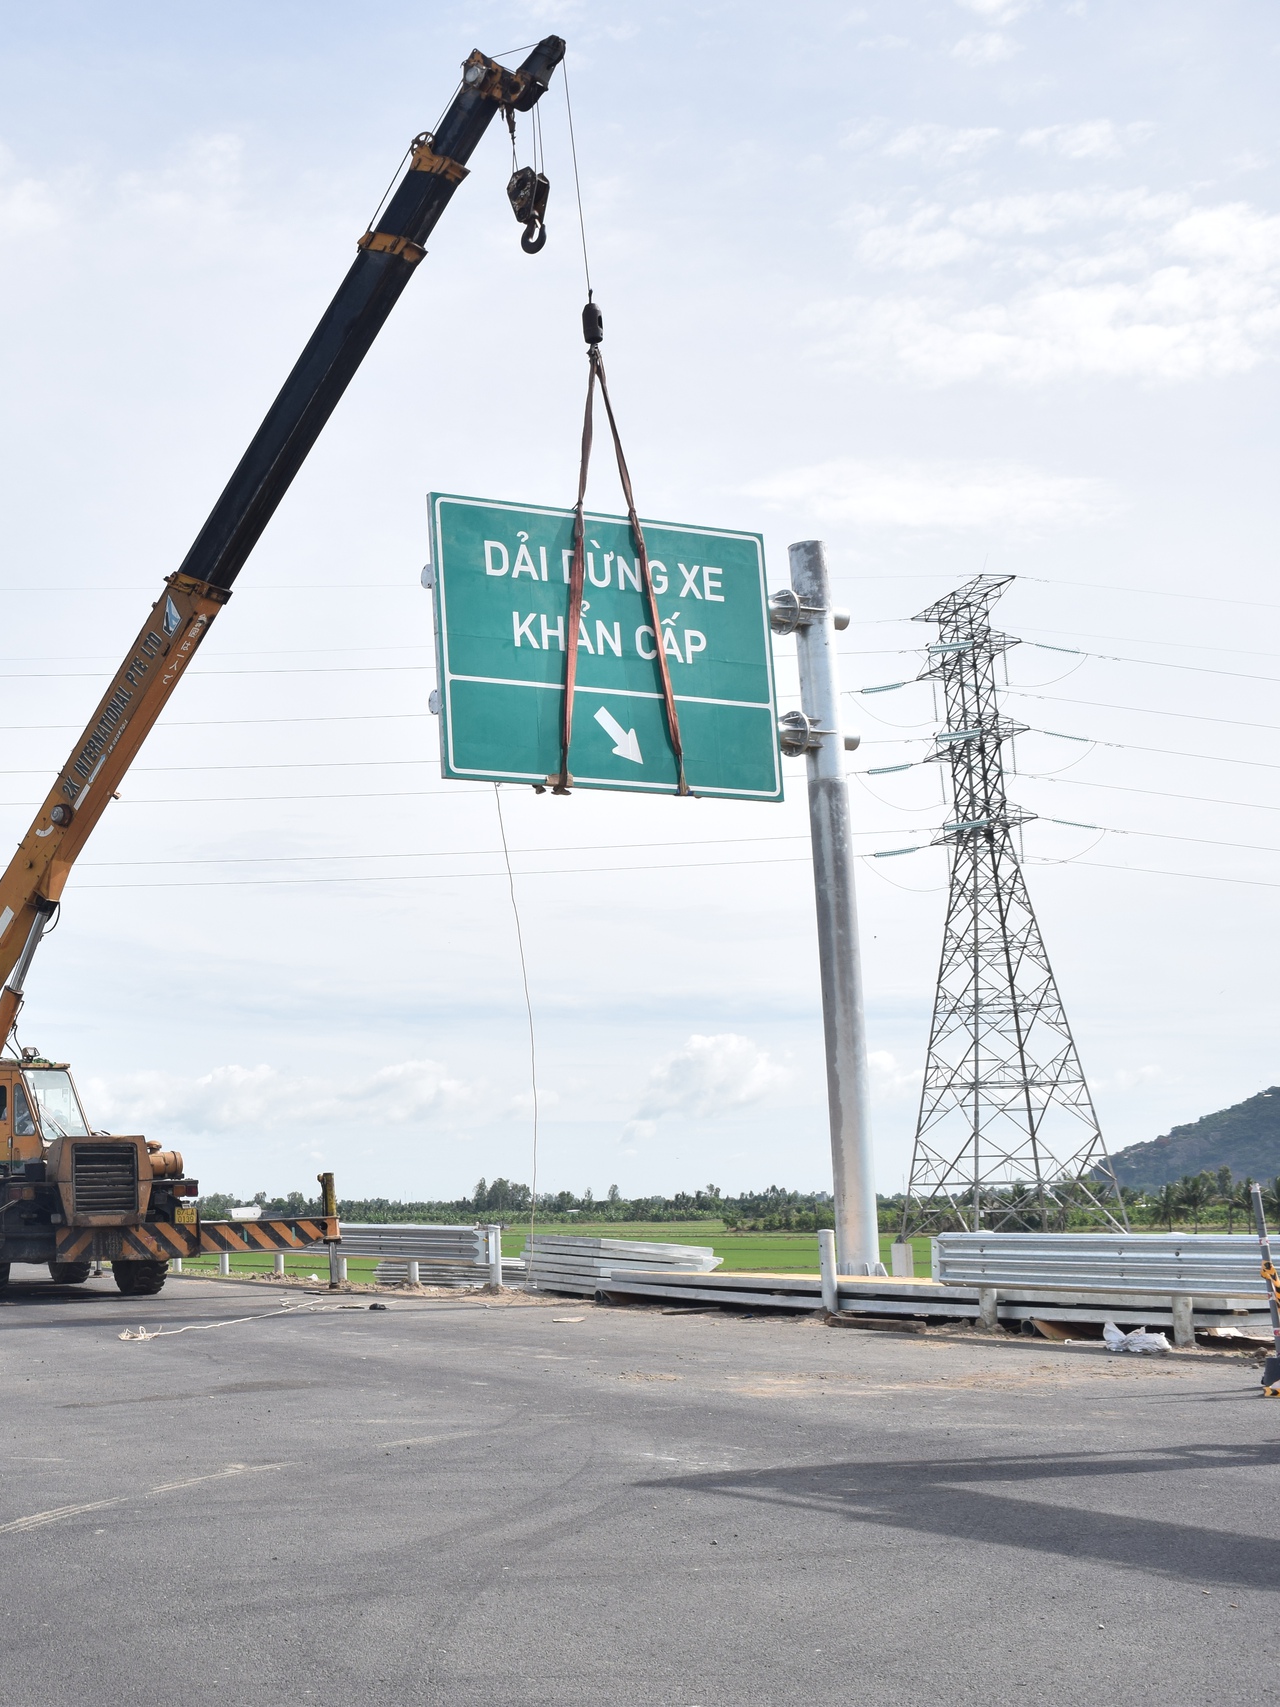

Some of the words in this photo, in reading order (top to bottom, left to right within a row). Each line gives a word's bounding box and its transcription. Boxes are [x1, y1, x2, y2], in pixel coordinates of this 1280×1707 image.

[483, 530, 549, 582] DẢI
[677, 562, 725, 603] XE
[634, 612, 708, 665] CẤP
[62, 775, 81, 801] 2K
[73, 685, 134, 779] INTERNATIONAL
[124, 655, 149, 688] PTE
[140, 630, 163, 661] LTD
[177, 1215, 195, 1223] 0139
